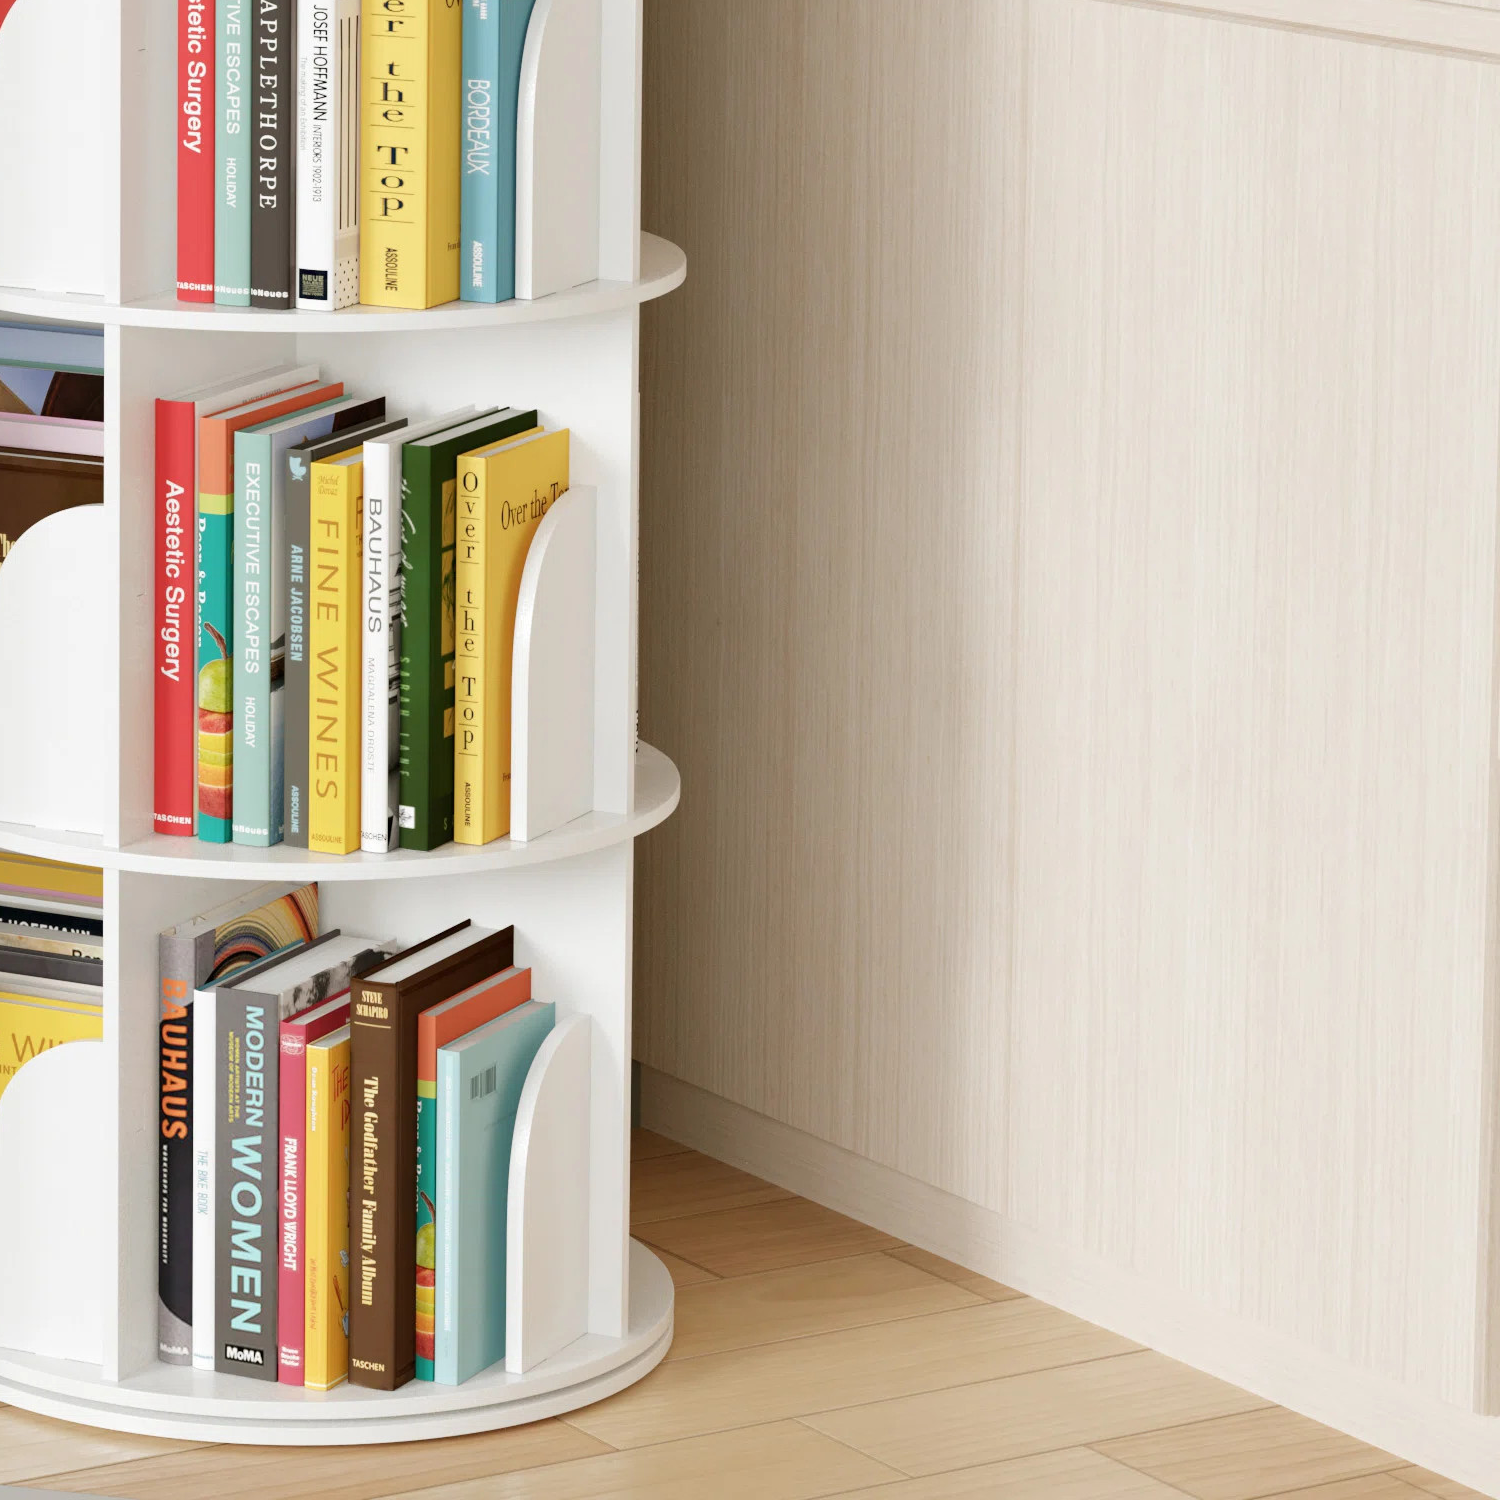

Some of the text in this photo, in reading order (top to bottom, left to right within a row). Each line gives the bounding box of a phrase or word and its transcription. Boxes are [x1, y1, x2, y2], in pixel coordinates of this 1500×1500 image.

[227, 43, 240, 134] ESCAPES
[383, 63, 403, 121] the
[467, 80, 490, 175] BORDEAUX
[226, 158, 236, 207] HOLIDAY
[177, 282, 212, 291] TASCHEN
[385, 248, 397, 291] ASSOULINE
[470, 241, 483, 287] ASSOULINE
[463, 472, 478, 559] Over
[502, 501, 527, 530] Over
[161, 480, 185, 681] Aestetic Surgery
[369, 499, 382, 632] BAUHAUS
[291, 545, 303, 661] ARNE JACOBSEN
[464, 591, 474, 651] the
[316, 519, 339, 798] FINE WINES
[152, 812, 193, 824] TASCHEN
[291, 786, 299, 833] ASSOULINE
[312, 833, 342, 844] ASSOULINE
[356, 1004, 388, 1019] SCHAPIRO
[362, 991, 382, 1004] STEVE
[161, 978, 188, 1138] BAUHAUS
[231, 1006, 264, 1333] MODERN WOMEN
[361, 1077, 378, 1305] The Godfather Family Album
[284, 1138, 297, 1271] FRANK LLOYD WRIGHT
[227, 1346, 263, 1364] MoMA
[352, 1359, 384, 1371] TASCHEN
